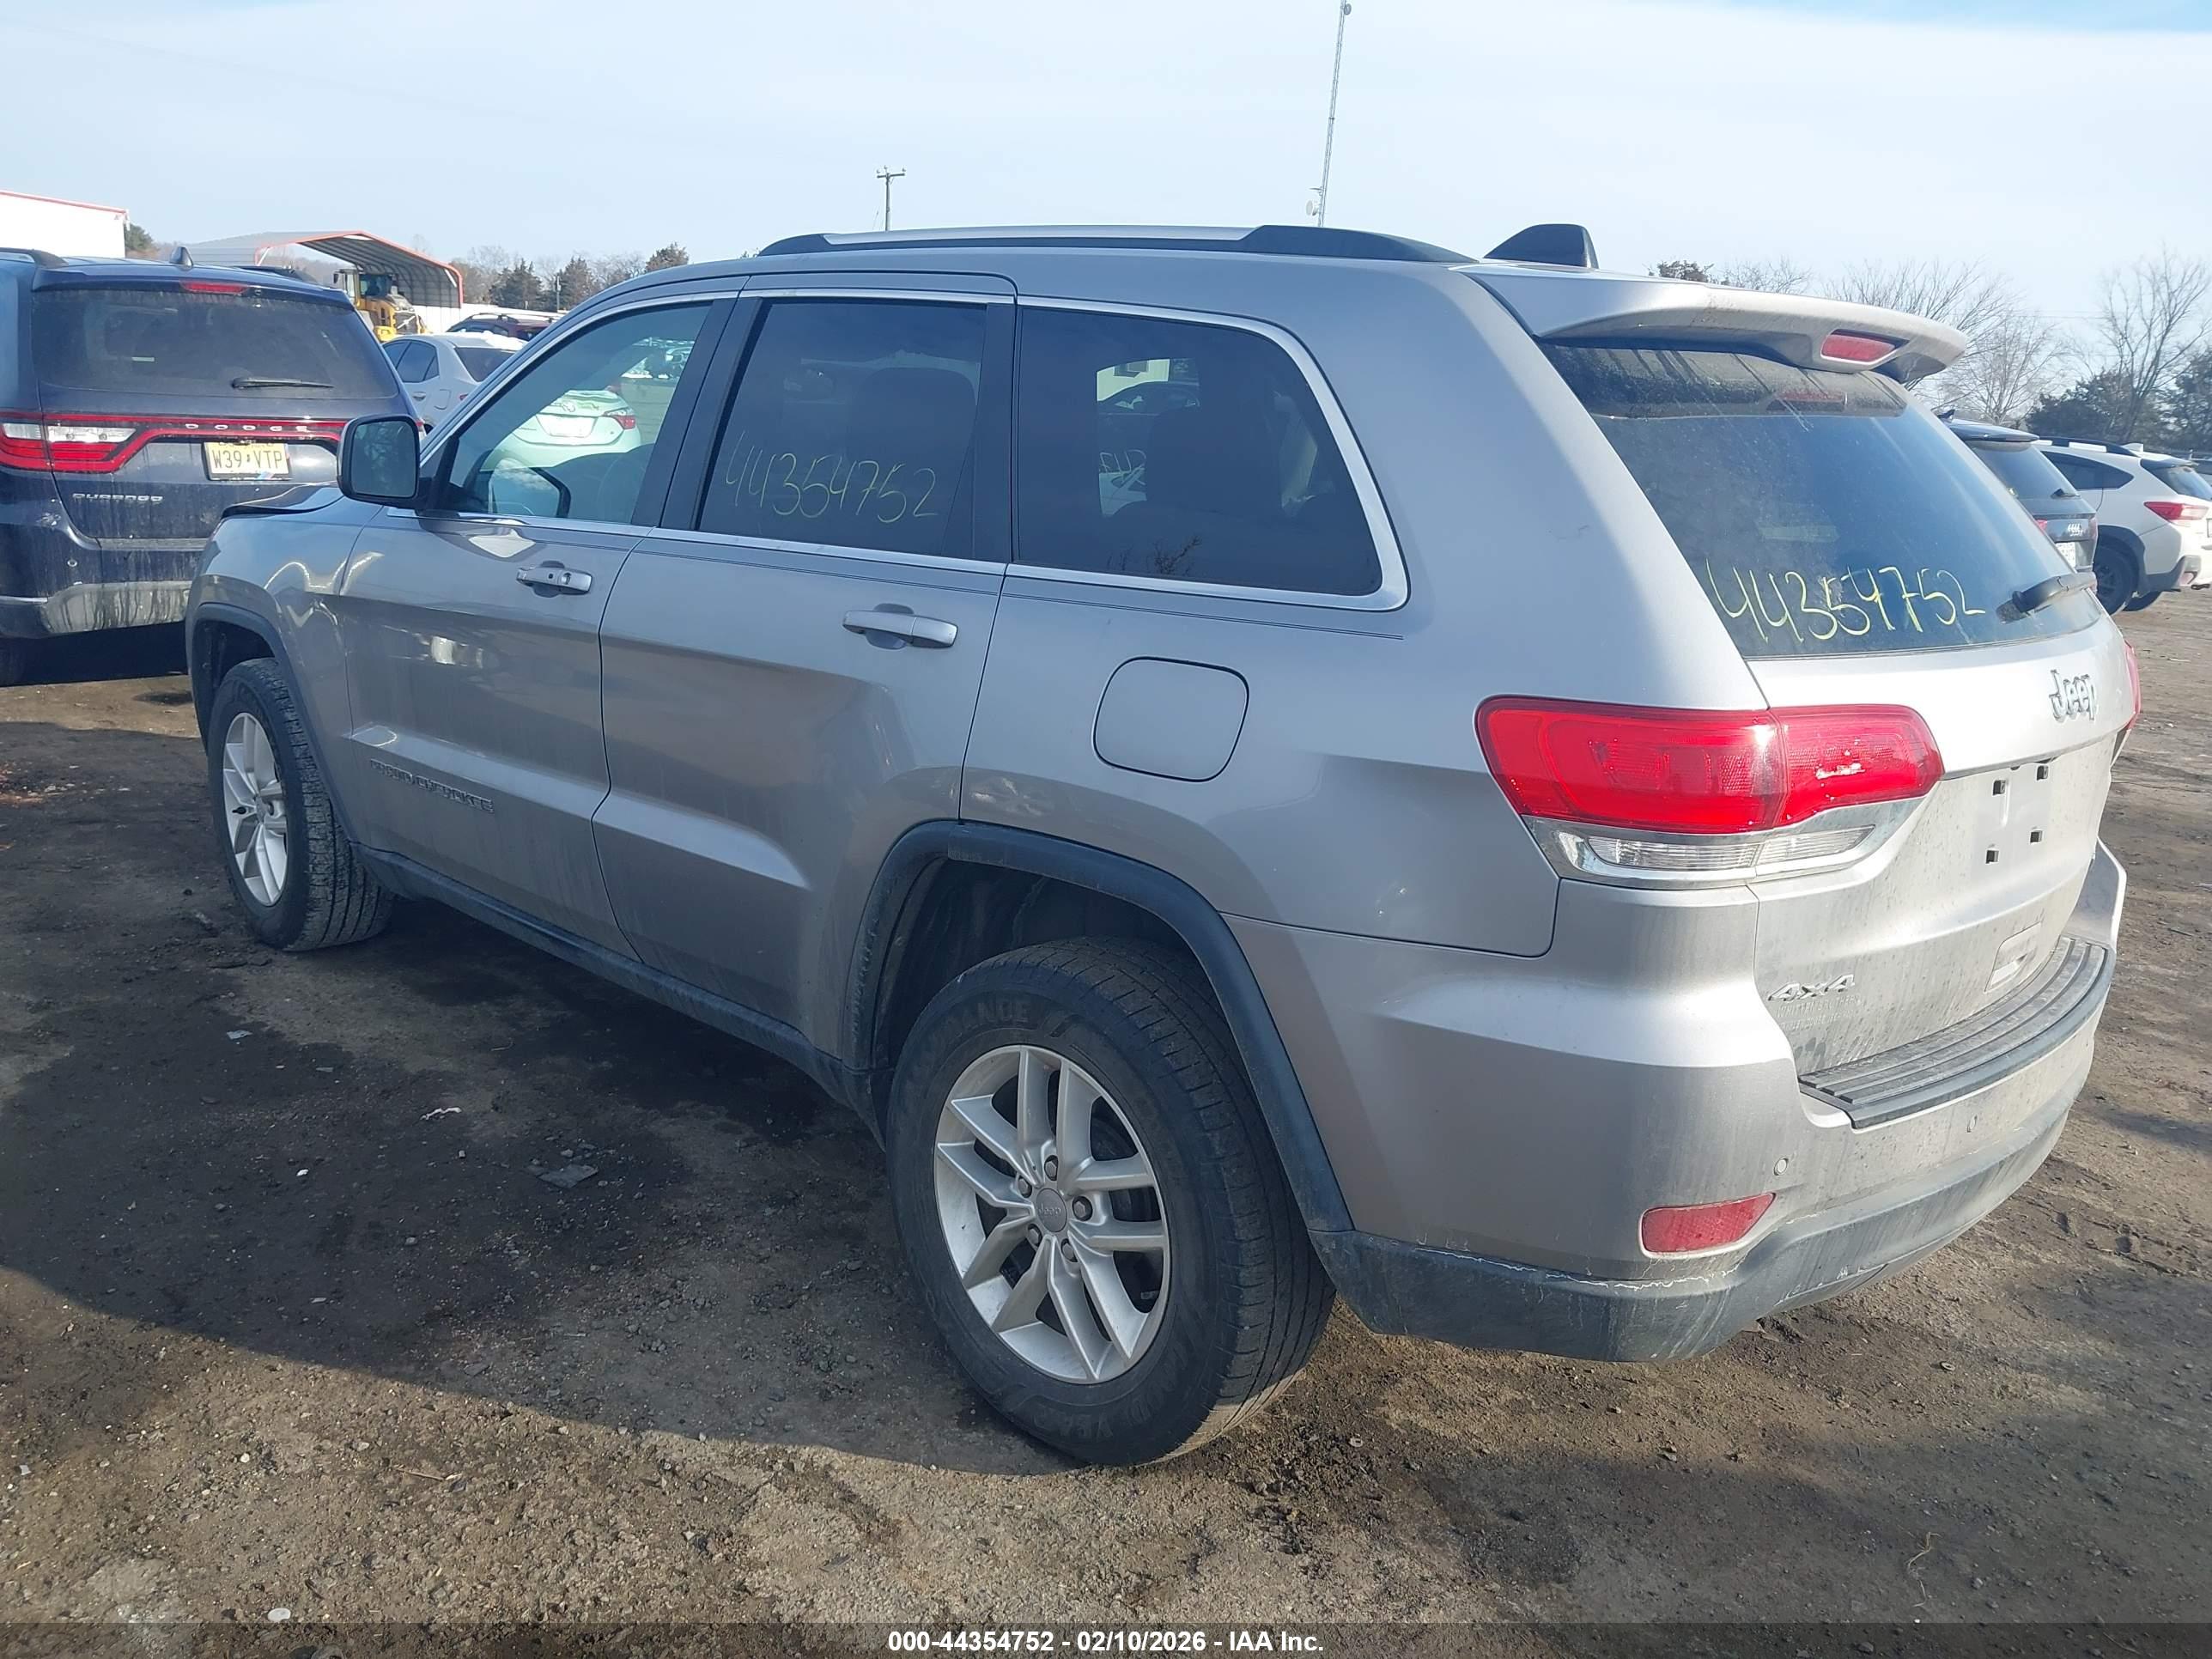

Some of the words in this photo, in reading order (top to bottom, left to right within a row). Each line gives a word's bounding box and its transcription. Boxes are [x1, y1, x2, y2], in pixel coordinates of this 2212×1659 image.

[185, 423, 309, 433] DODGE
[211, 449, 243, 469] W39
[252, 449, 283, 469] VTP
[725, 431, 939, 523] 44354752
[72, 493, 163, 501] DURANGO
[1705, 558, 1986, 645] 44354752
[2049, 669, 2095, 721] Jeep
[1767, 973, 1856, 1002] 4x4
